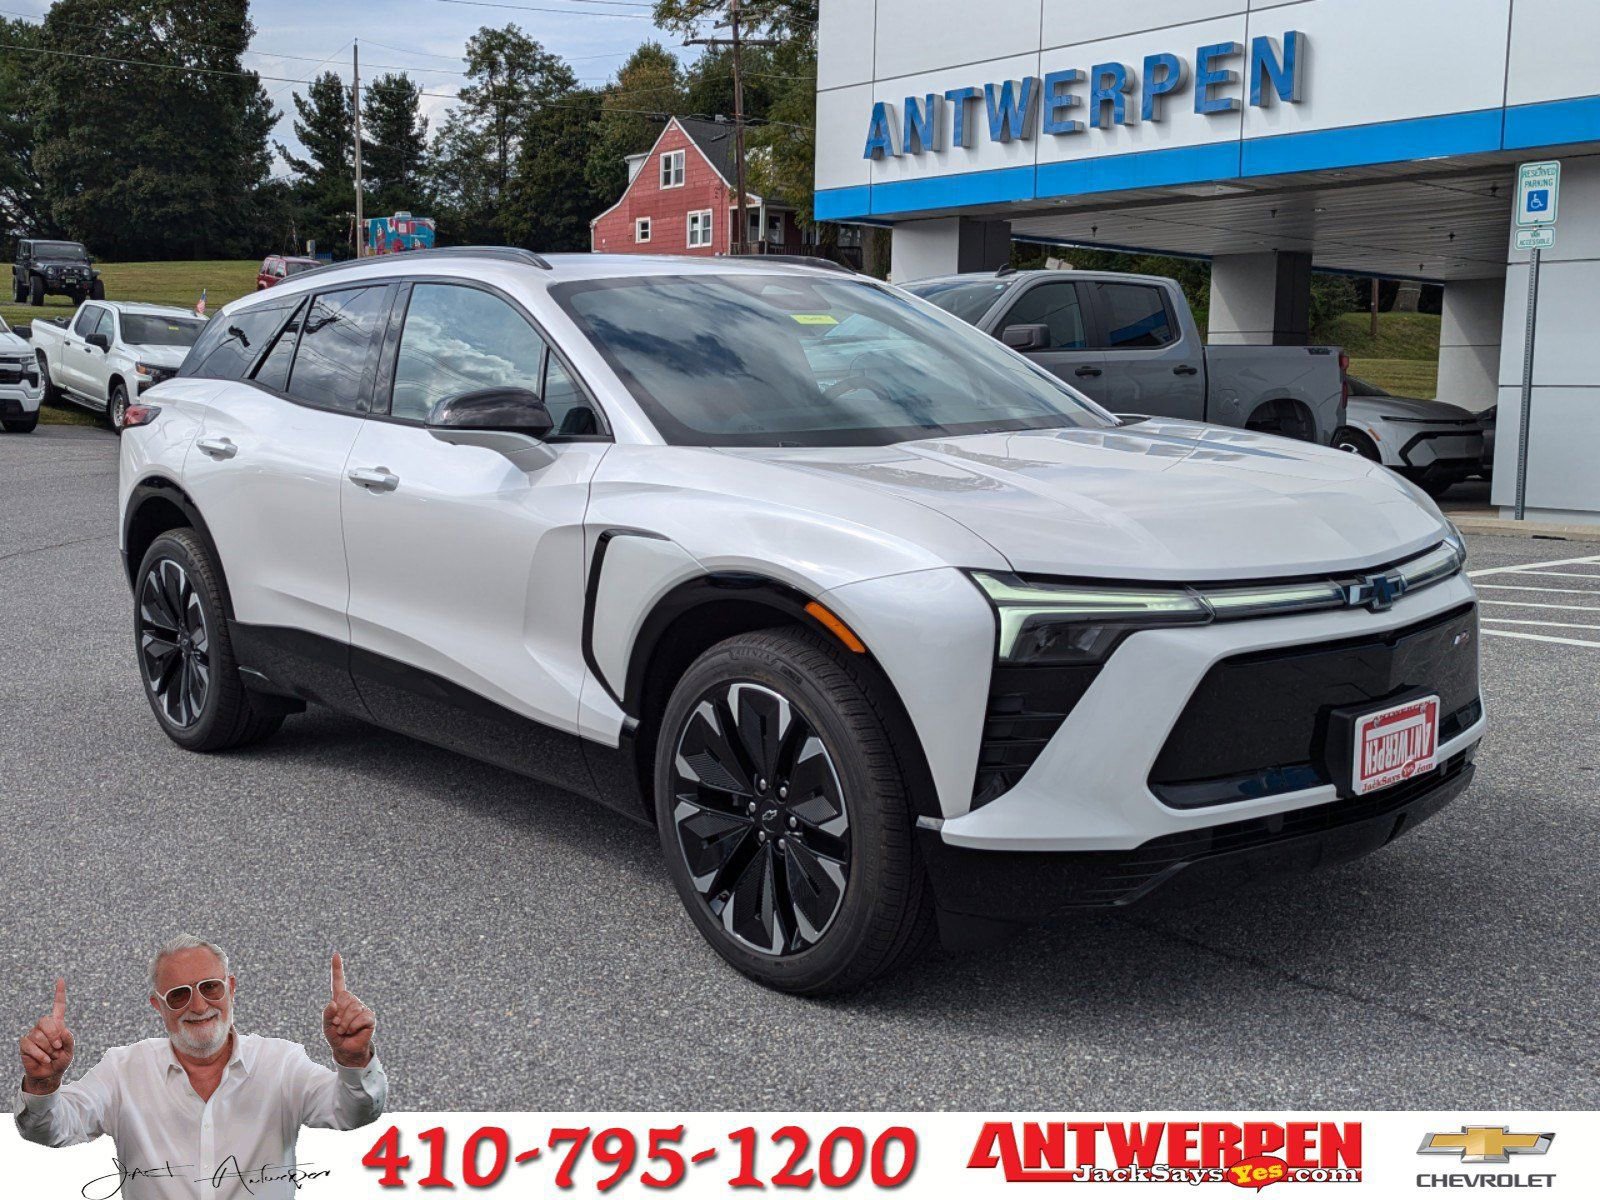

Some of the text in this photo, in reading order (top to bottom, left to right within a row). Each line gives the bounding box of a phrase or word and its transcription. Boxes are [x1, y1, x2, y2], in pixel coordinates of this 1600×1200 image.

[863, 30, 1305, 160] ANTWERPEN
[1522, 167, 1556, 178] RESERVED
[1524, 177, 1554, 188] PARKING
